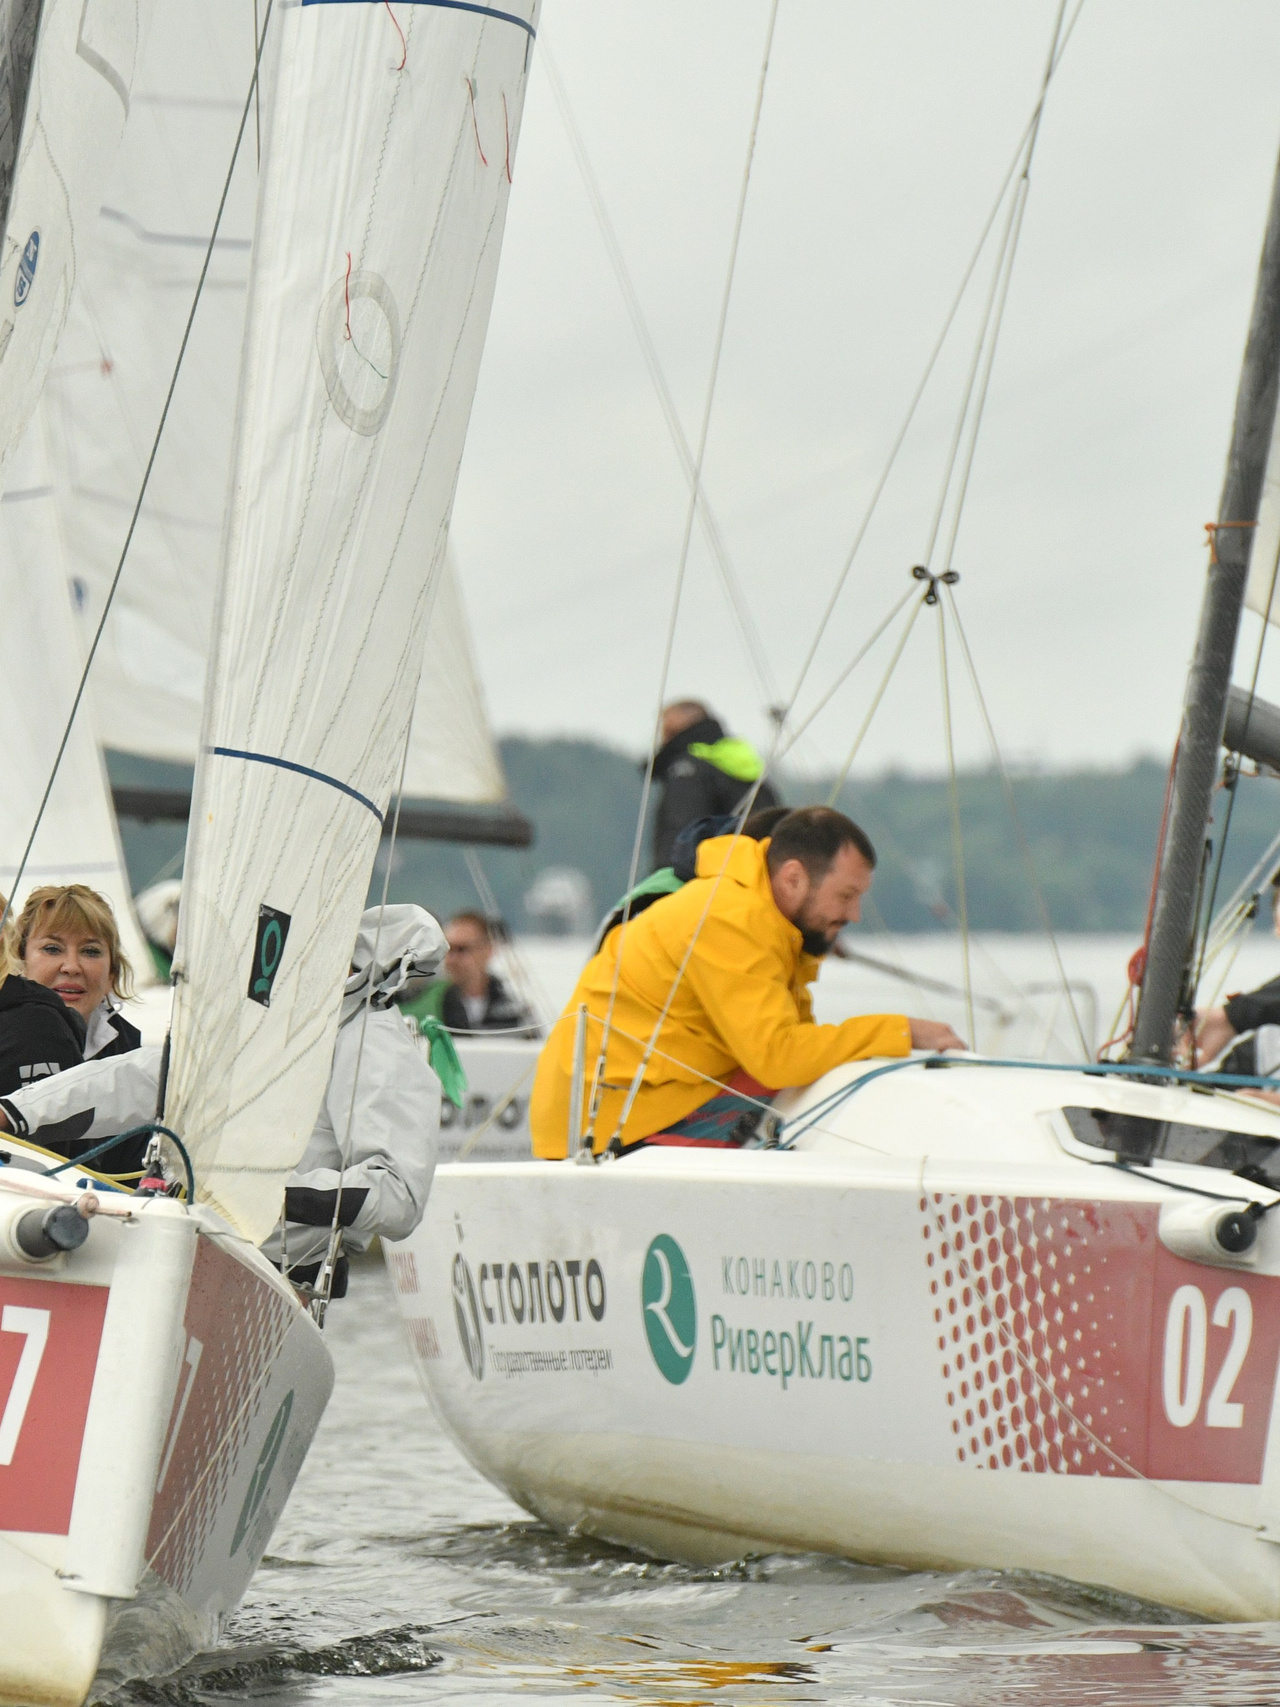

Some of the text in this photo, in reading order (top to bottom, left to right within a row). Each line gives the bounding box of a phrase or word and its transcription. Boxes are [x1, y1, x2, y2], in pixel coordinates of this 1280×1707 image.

[722, 1256, 854, 1302] КОНАКОВО
[711, 1314, 873, 1390] РиверКлаб
[1163, 1284, 1253, 1428] 02
